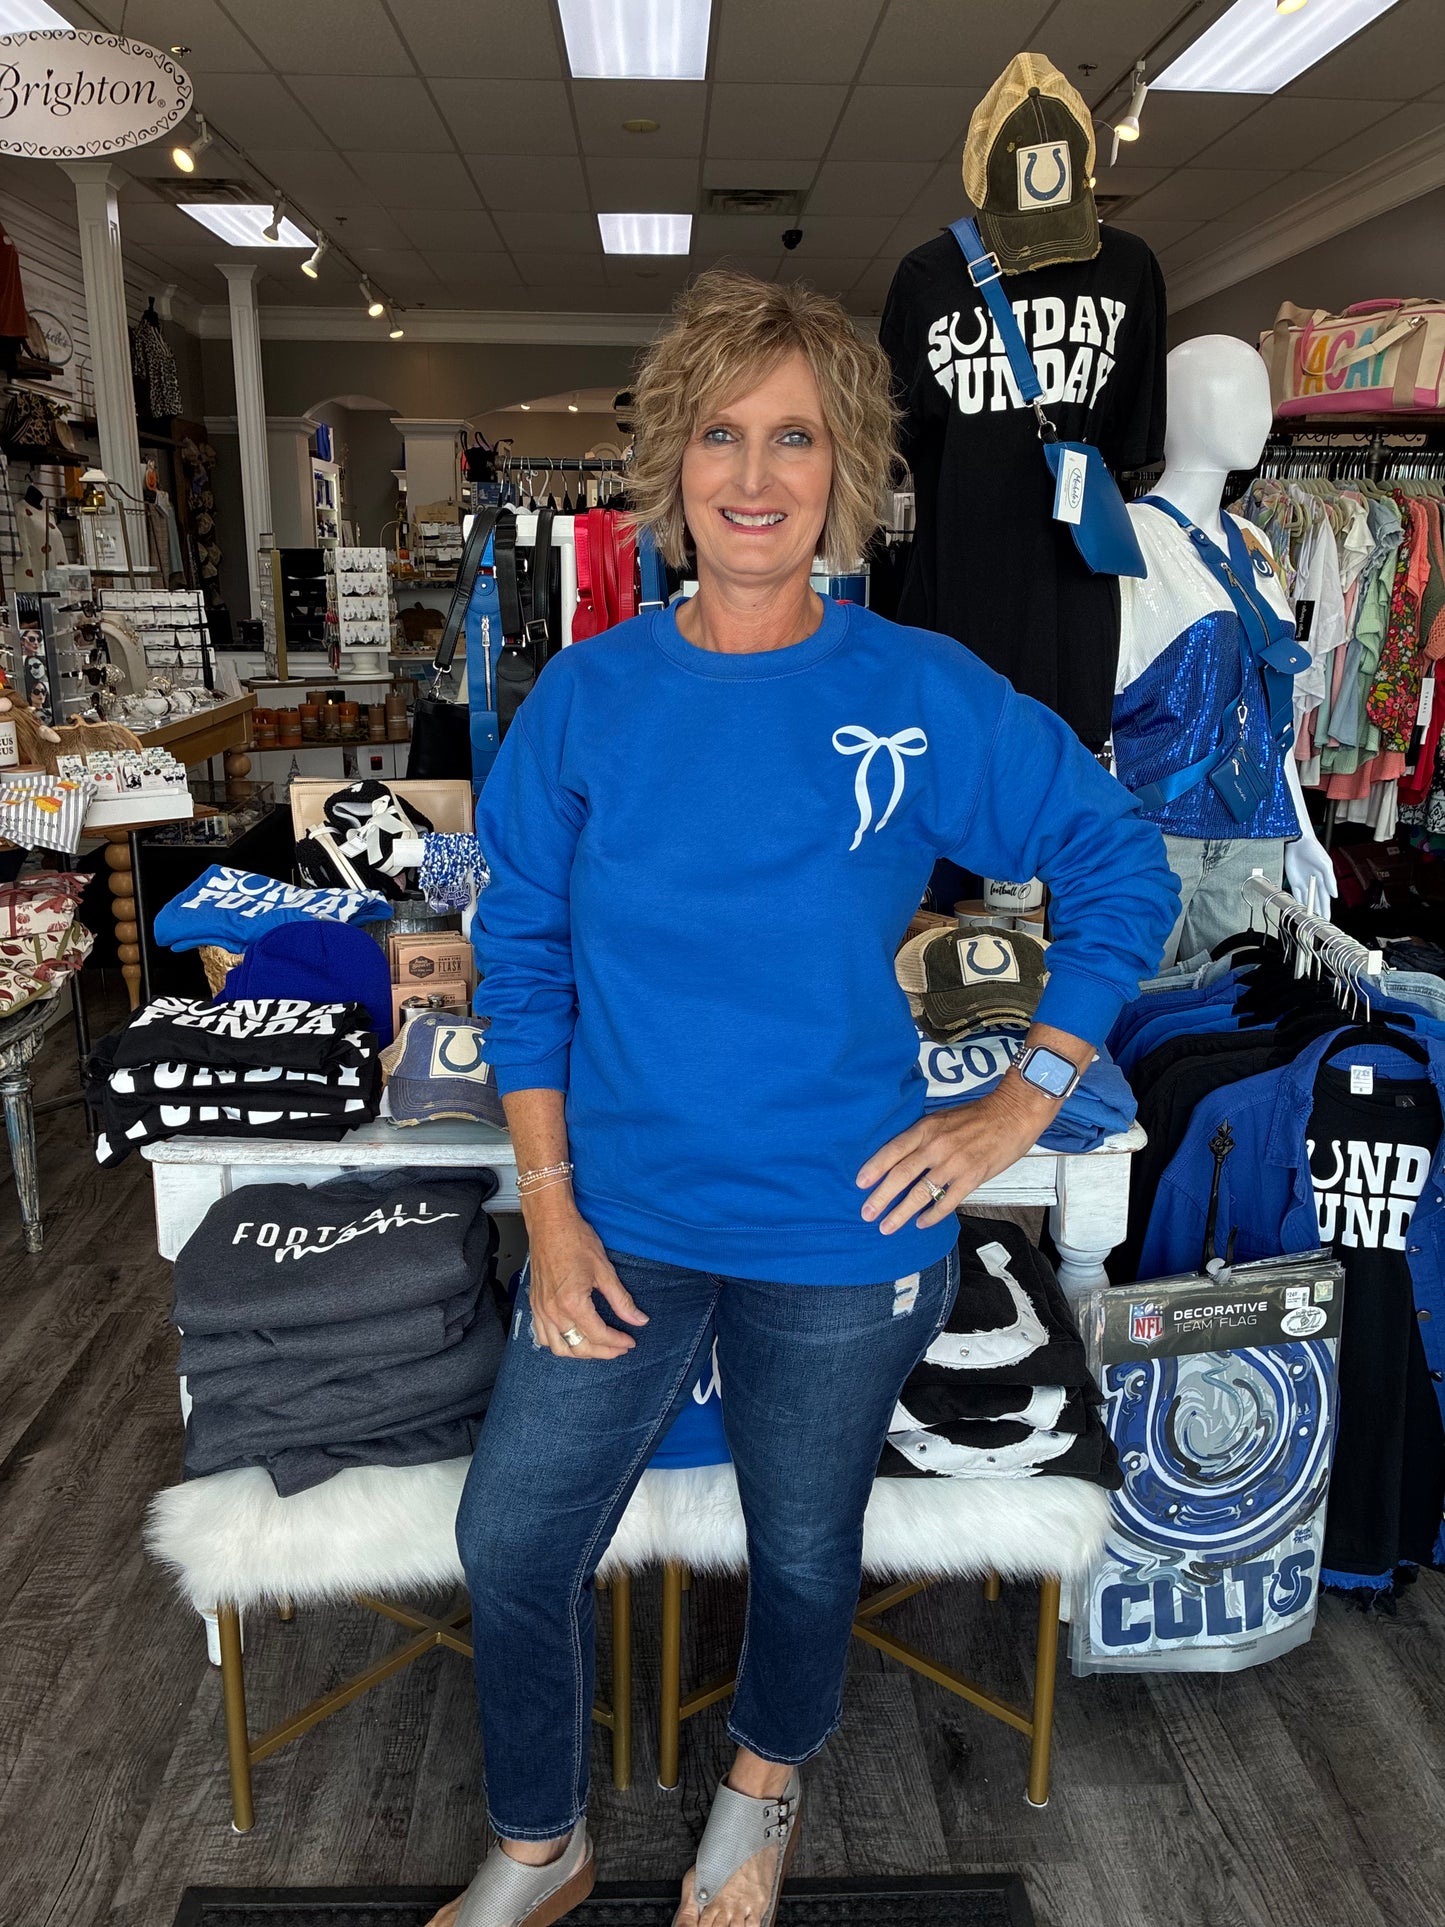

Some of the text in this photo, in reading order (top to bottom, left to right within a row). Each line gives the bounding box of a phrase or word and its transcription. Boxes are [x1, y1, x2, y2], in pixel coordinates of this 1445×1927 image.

[0, 737, 14, 746] US
[0, 746, 14, 755] US
[1173, 1301, 1268, 1321] DECORATIVE
[1134, 1316, 1163, 1340] NFL
[1173, 1314, 1257, 1333] TEAM FLAG
[1101, 1549, 1315, 1647] COLTS
